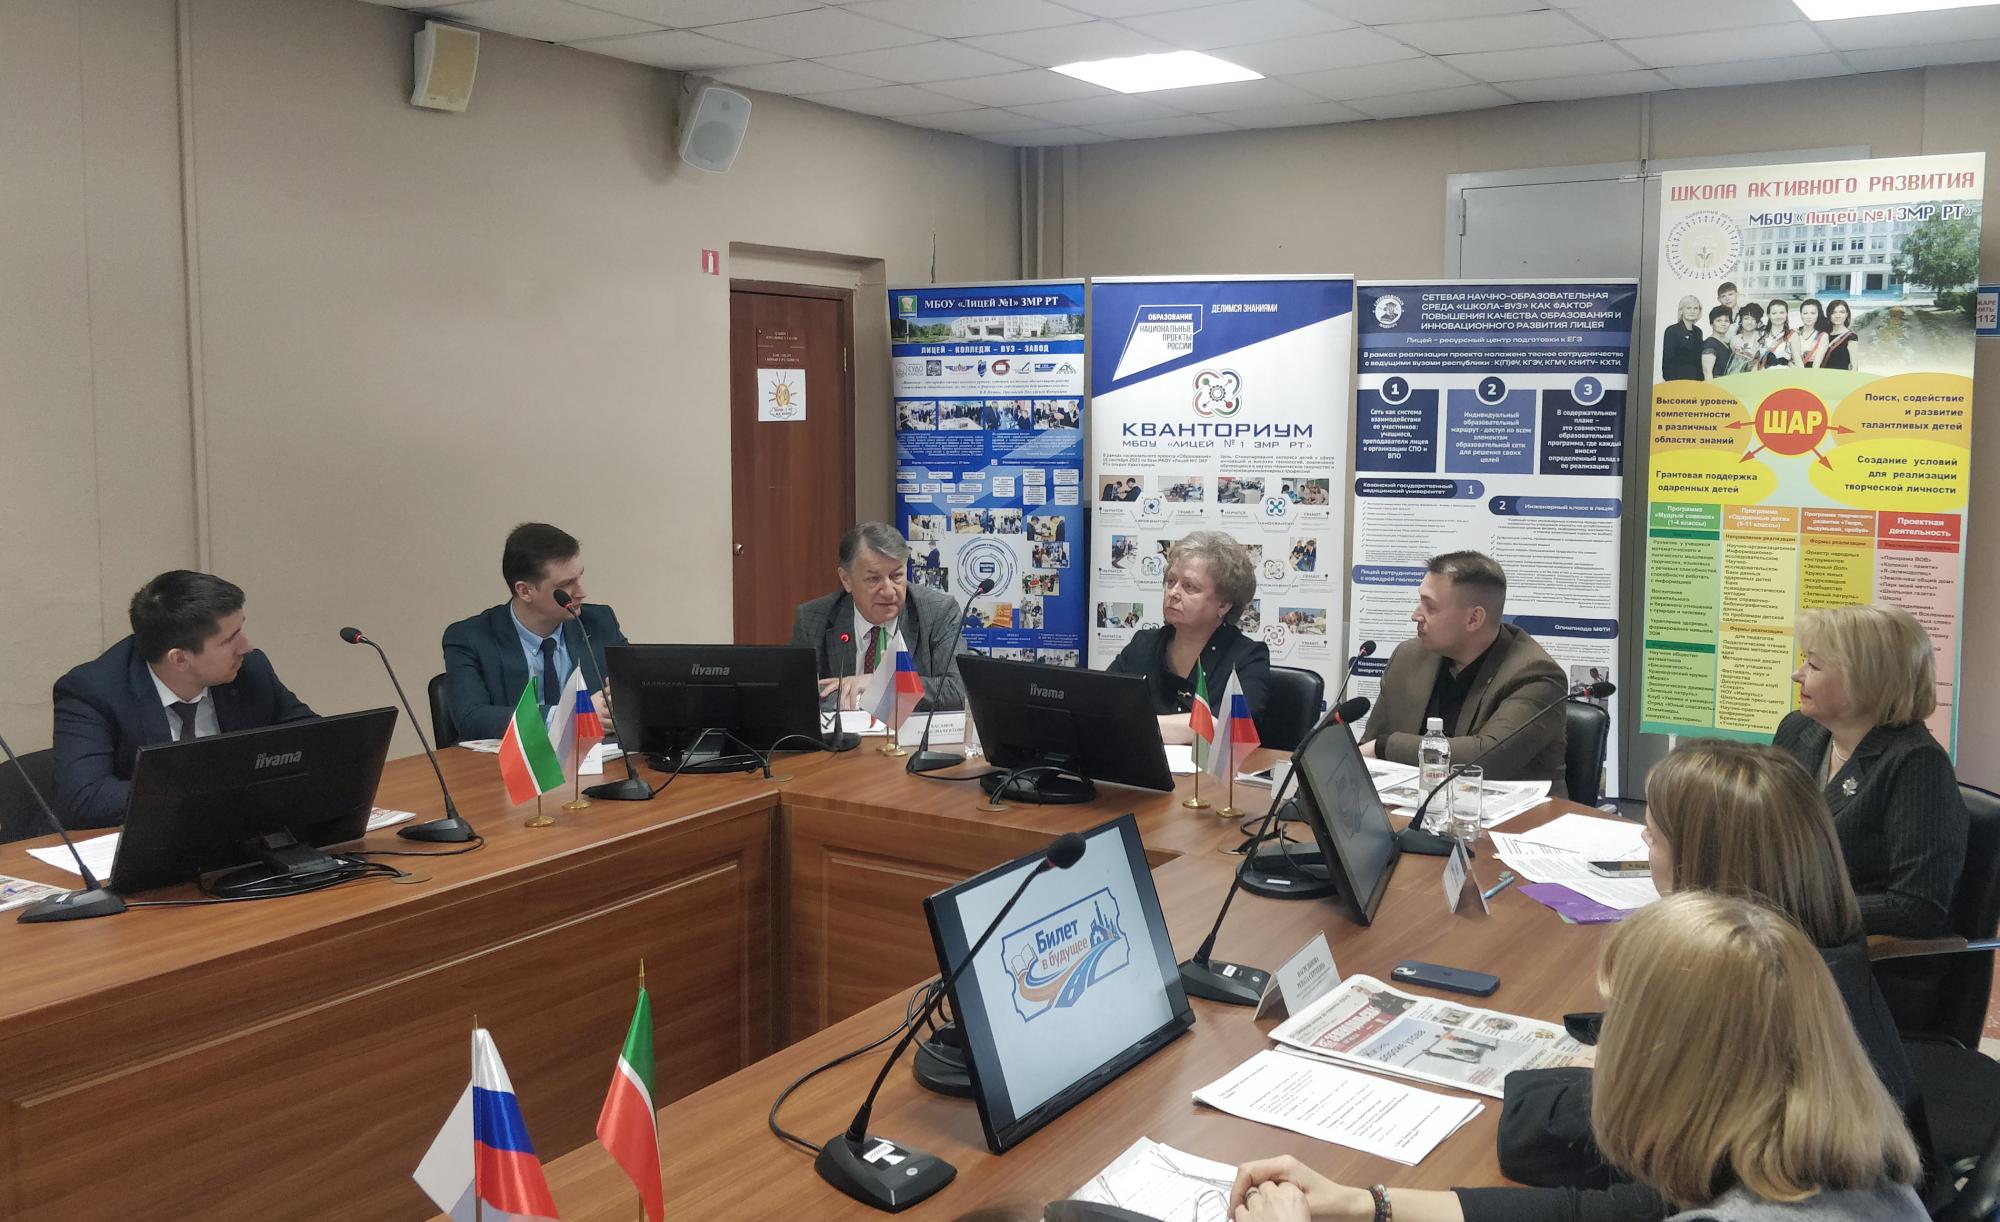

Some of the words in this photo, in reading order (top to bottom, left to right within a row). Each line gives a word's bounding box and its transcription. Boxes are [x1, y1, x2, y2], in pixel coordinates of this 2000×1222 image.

[1671, 184, 1737, 201] ШКОЛА
[1748, 178, 1857, 198] АКТИВНОГО
[1869, 172, 1974, 192] РАЗВИТИЯ
[1750, 212, 1792, 226] МБОУ
[1897, 206, 1934, 220] ЗМР
[1467, 292, 1609, 300] НАУЧНО-ОБРАЗОВАТЕЛЬНАЯ
[925, 300, 955, 309] МБОУ
[958, 299, 995, 308] «Лицей
[1021, 298, 1042, 306] ЗМР
[1045, 296, 1058, 305] РТ
[1422, 303, 1454, 311] СРЕДА
[1212, 304, 1242, 313] ДЕЛИМСЯ
[1243, 304, 1278, 312] ЗНАНИЯМИ
[1487, 312, 1538, 320] КАЧЕСТВА
[1140, 324, 1192, 333] НАЦИОНАЛЬНЫЕ
[1421, 322, 1514, 330] ИННОВАЦИОННОГО
[1162, 333, 1192, 342] ПРОЕКТЫ
[921, 346, 945, 354] ЛИЦЕЙ
[955, 345, 990, 353] КОЛЛЕДЖ
[1001, 345, 1015, 353] ВУЗ
[1024, 344, 1049, 353] ЗАВОД
[1167, 342, 1192, 350] РОССИИ
[1391, 384, 1399, 395] 1
[1488, 384, 1496, 395] 2
[1584, 384, 1593, 395] 3
[1656, 397, 1697, 405] Высокий
[1865, 394, 1900, 402] Поиск,
[1903, 394, 1964, 402] содействие
[1763, 410, 1822, 435] ШАР
[1123, 422, 1313, 438] КВАНТОРИУМ
[1167, 440, 1214, 448] «ЛИЦЕЙ
[1858, 456, 1908, 464] Создание
[1656, 471, 1702, 479] Грантовая
[1706, 473, 1758, 481] поддержка
[1893, 472, 1957, 480] реализации
[1468, 485, 1474, 494] 1
[1845, 484, 1903, 492] творческой
[1499, 501, 1506, 510] 2
[1897, 517, 1944, 526] Проектная
[1889, 528, 1951, 536] деятельность
[1554, 624, 1592, 632] Олимпиада
[691, 664, 730, 676] iiyama
[1030, 682, 1064, 699] iiyama
[254, 751, 302, 769] iiyama
[1035, 920, 1077, 954] Билет
[1042, 959, 1048, 970] в
[1049, 938, 1088, 968] будущее
